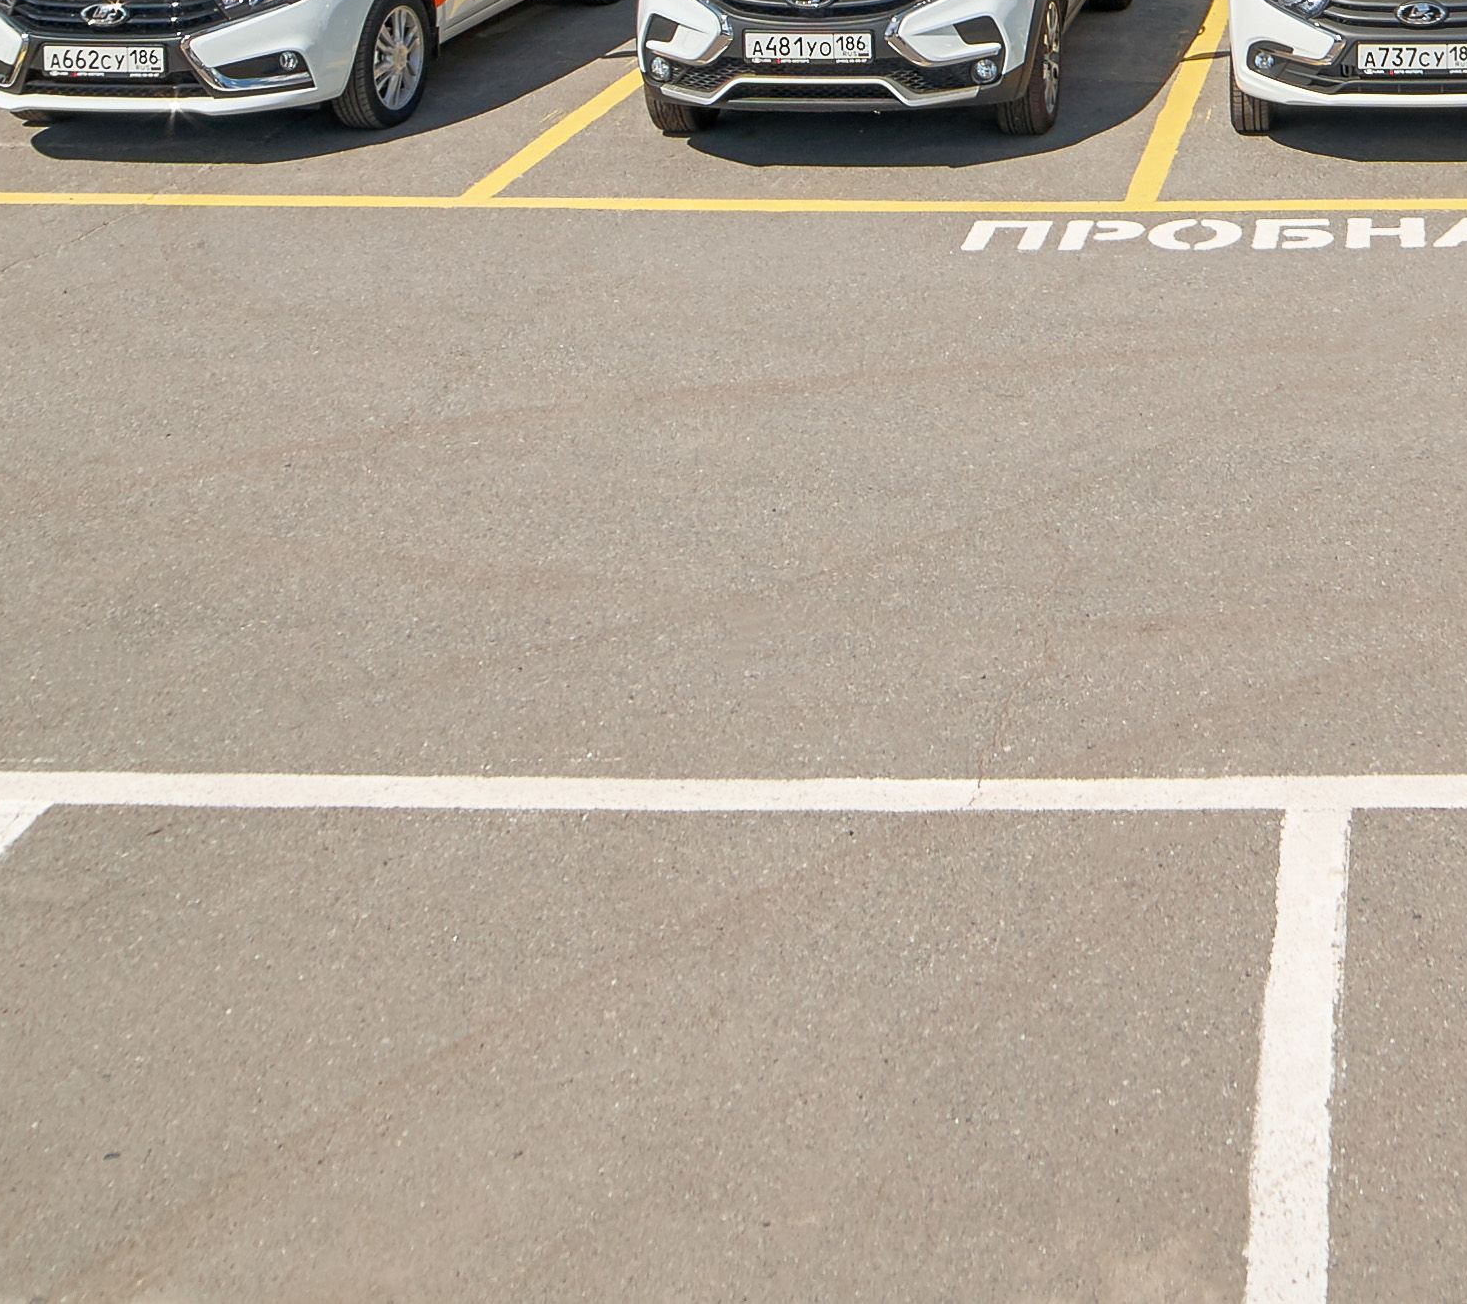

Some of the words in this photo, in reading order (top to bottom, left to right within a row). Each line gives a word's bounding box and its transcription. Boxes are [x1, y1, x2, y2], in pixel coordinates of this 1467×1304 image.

[753, 37, 831, 57] А481УО
[836, 36, 865, 51] 186
[50, 50, 125, 70] А662СУ
[130, 50, 159, 64] 186
[1364, 48, 1444, 67] А737СУ
